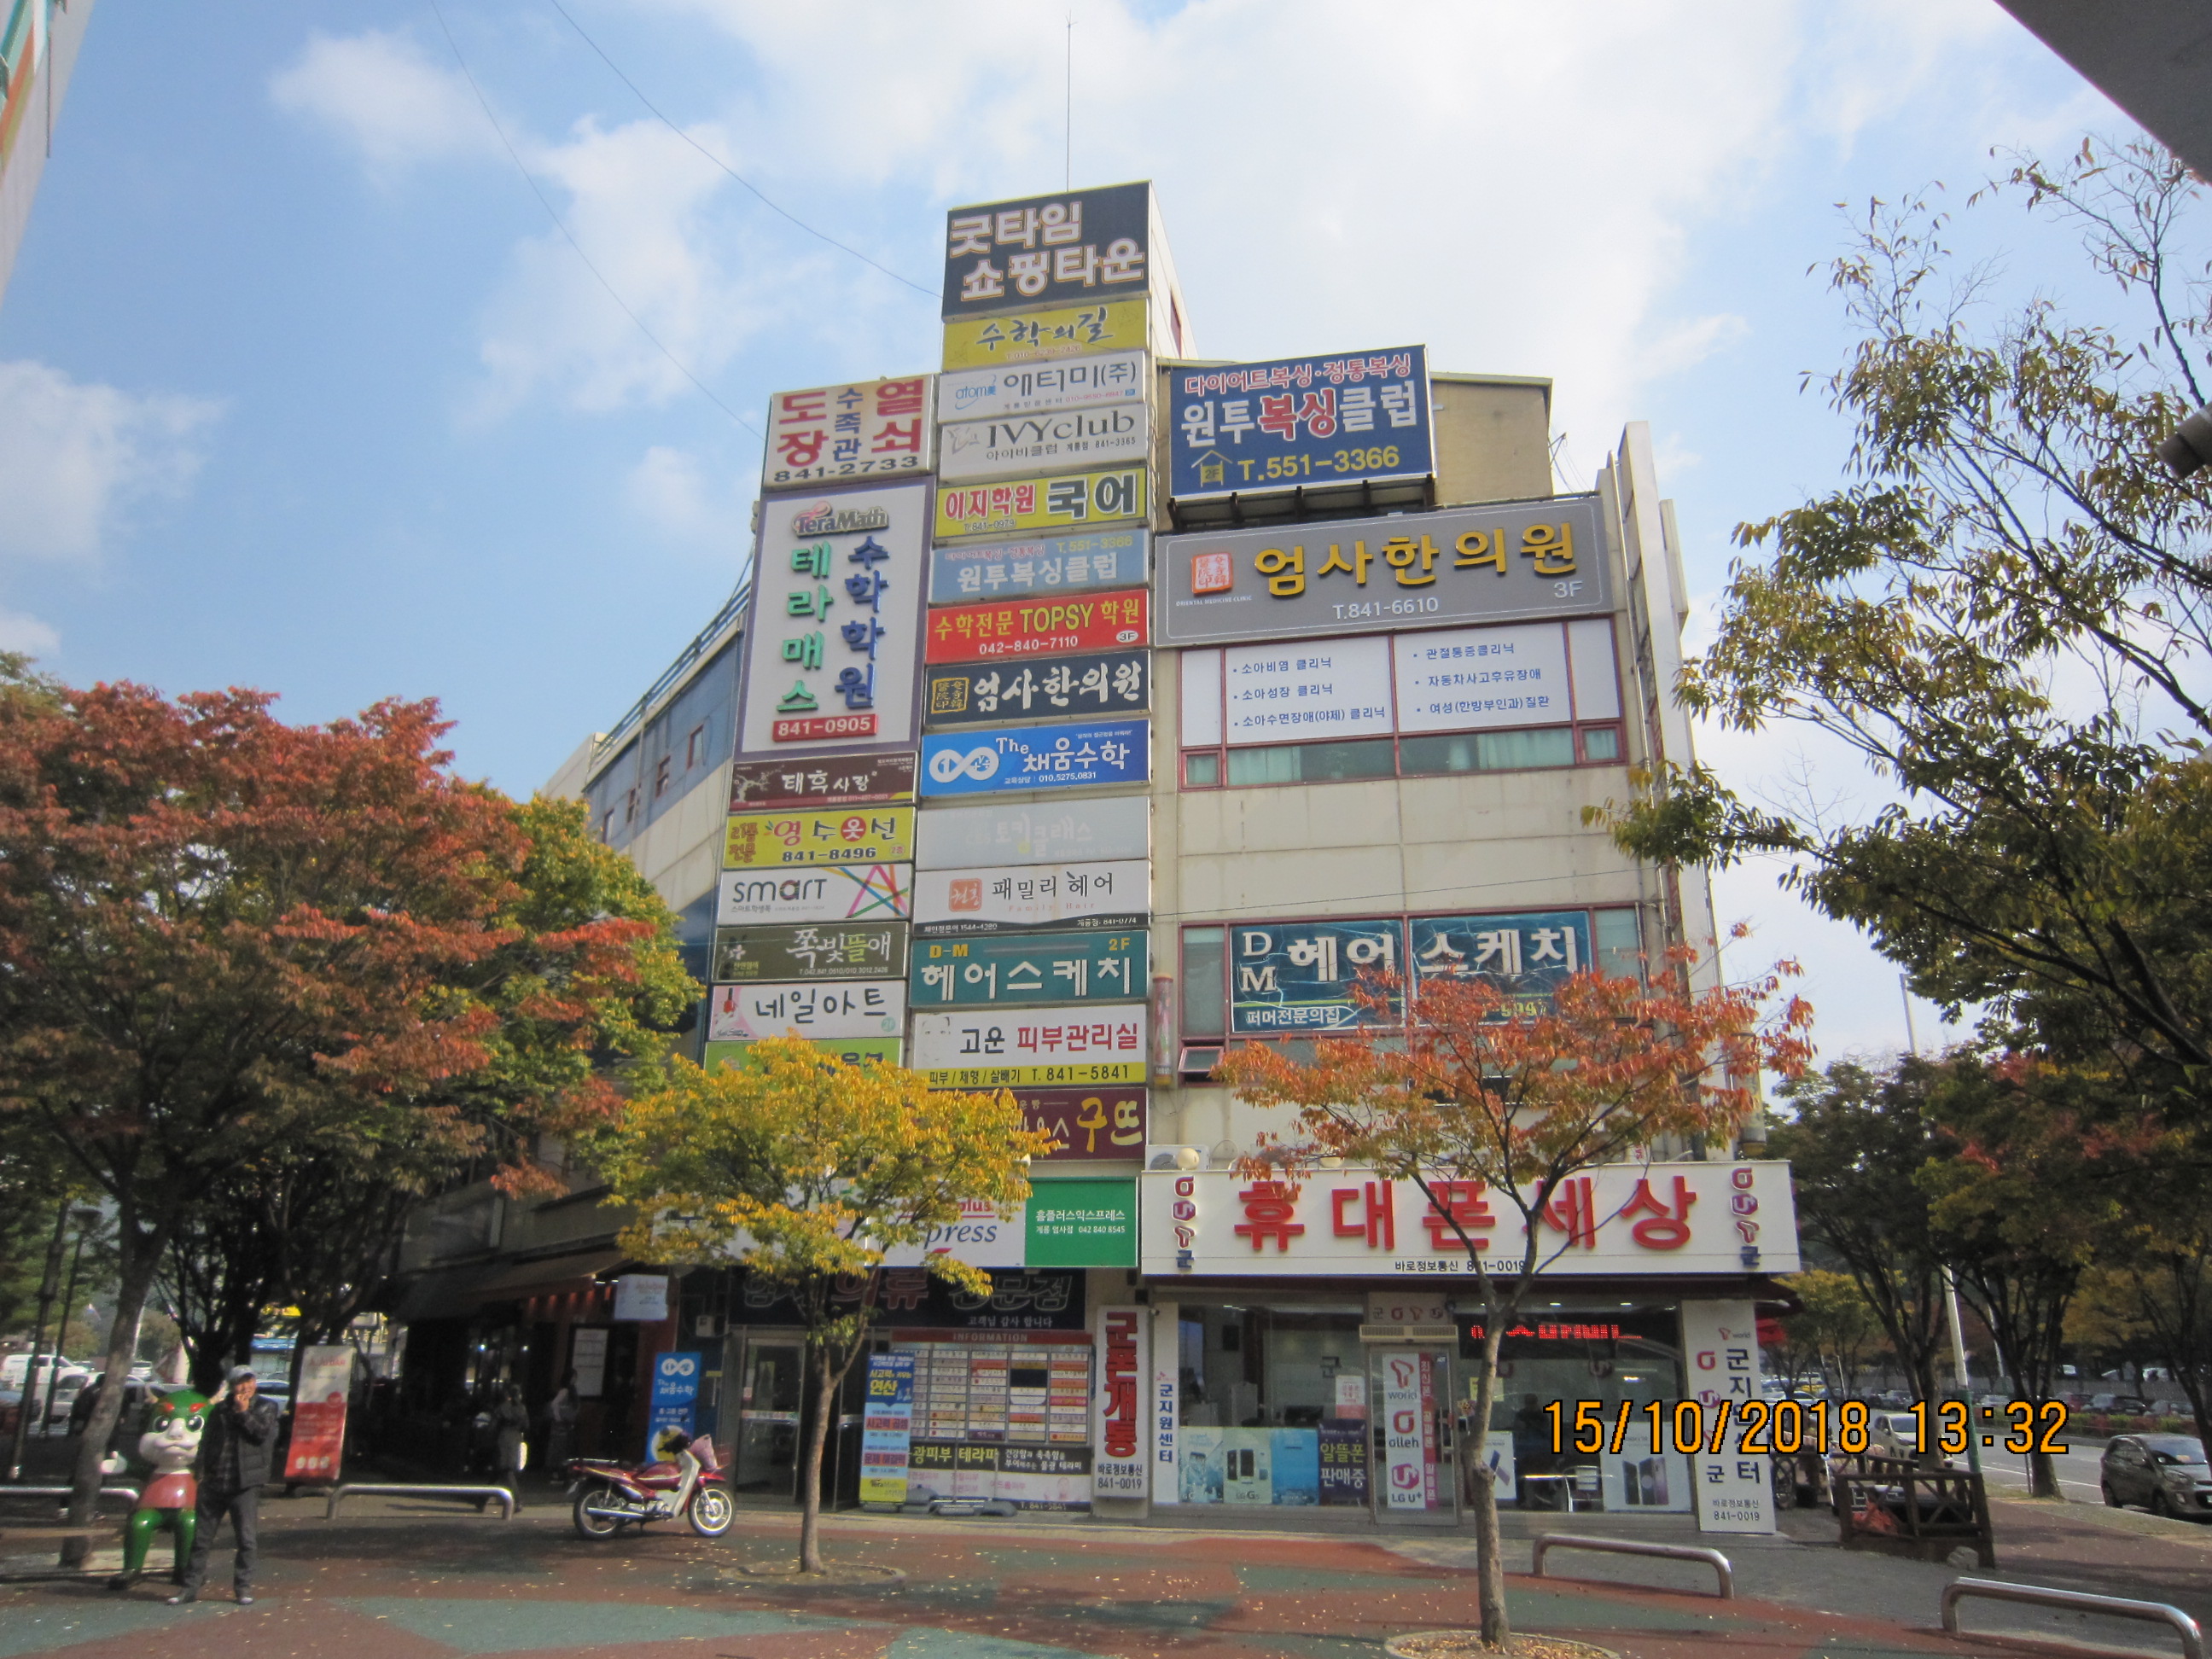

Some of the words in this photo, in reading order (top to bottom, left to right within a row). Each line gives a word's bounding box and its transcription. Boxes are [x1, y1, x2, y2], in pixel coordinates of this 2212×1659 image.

[950, 201, 1082, 258] 굿타임
[961, 238, 1145, 301] 쇼핑타운
[832, 387, 864, 463] 수족관
[871, 380, 924, 453] 열쇠
[1181, 380, 1417, 447] 원투복싱클럽
[777, 392, 830, 467] 도장
[987, 410, 1135, 448] IVYclub
[987, 443, 1058, 461] 아이비클럽
[1095, 436, 1137, 448] 841-3365
[773, 456, 918, 482] 841-2733
[1238, 445, 1400, 480] T.551-3366
[945, 483, 1035, 521] 이지학원
[1048, 472, 1137, 520] 국어
[794, 508, 888, 535] TeraMath
[1254, 521, 1577, 596] 엄사한의원
[957, 552, 1118, 592] 원투복싱클럽
[1553, 580, 1583, 598] 3F
[934, 610, 1014, 641] 수학전문
[1019, 602, 1094, 633] TOPSY
[1100, 598, 1139, 626] 학원
[1332, 597, 1439, 620] T.841-6610
[979, 635, 1078, 655] 042-840-7110
[1119, 632, 1136, 641] 3F
[1426, 643, 1515, 660] 관절통증클리닉
[1242, 660, 1289, 674] 소아비염
[1296, 657, 1331, 671] 클리닉
[974, 661, 1142, 712] 엄사한의원
[1243, 686, 1289, 701] 소아성장
[1297, 684, 1333, 696] 클리닉
[1350, 707, 1385, 719] 클리닉
[1526, 696, 1549, 707] 질환
[777, 717, 870, 736] 841-0905
[996, 737, 1029, 754] The
[1023, 737, 1131, 773] 채움수학
[1039, 771, 1097, 783] 010.5275.0831
[782, 847, 876, 862] 841-8496
[992, 876, 1057, 900] 패밀리
[1067, 871, 1114, 898] 헤어
[1109, 937, 1131, 951] 2F
[921, 957, 1131, 1001] 헤어스케치
[755, 988, 888, 1024] 네일아트
[960, 1027, 1005, 1054] 고운
[1017, 1023, 1138, 1054] 피부관리실
[1036, 1209, 1126, 1222] 홈플러스익스프레스
[1234, 1175, 1697, 1251] 휴대폰세상
[1078, 1225, 1091, 1234] 042
[1093, 1225, 1107, 1234] 840
[1394, 1260, 1459, 1272] 바로정보통신
[1023, 1315, 1052, 1327] 합니다
[952, 1333, 1028, 1342] INFORMATION
[1388, 1388, 1418, 1400] world
[1158, 1383, 1173, 1464] 군지원센터
[1097, 1464, 1143, 1476] 바로정보통신
[1320, 1467, 1365, 1489] 판매중
[1097, 1477, 1143, 1490] 841-0019
[1392, 1493, 1406, 1503] LG
[1712, 1498, 1760, 1509] 바로정보통신
[1714, 1511, 1761, 1522] 841-0019
